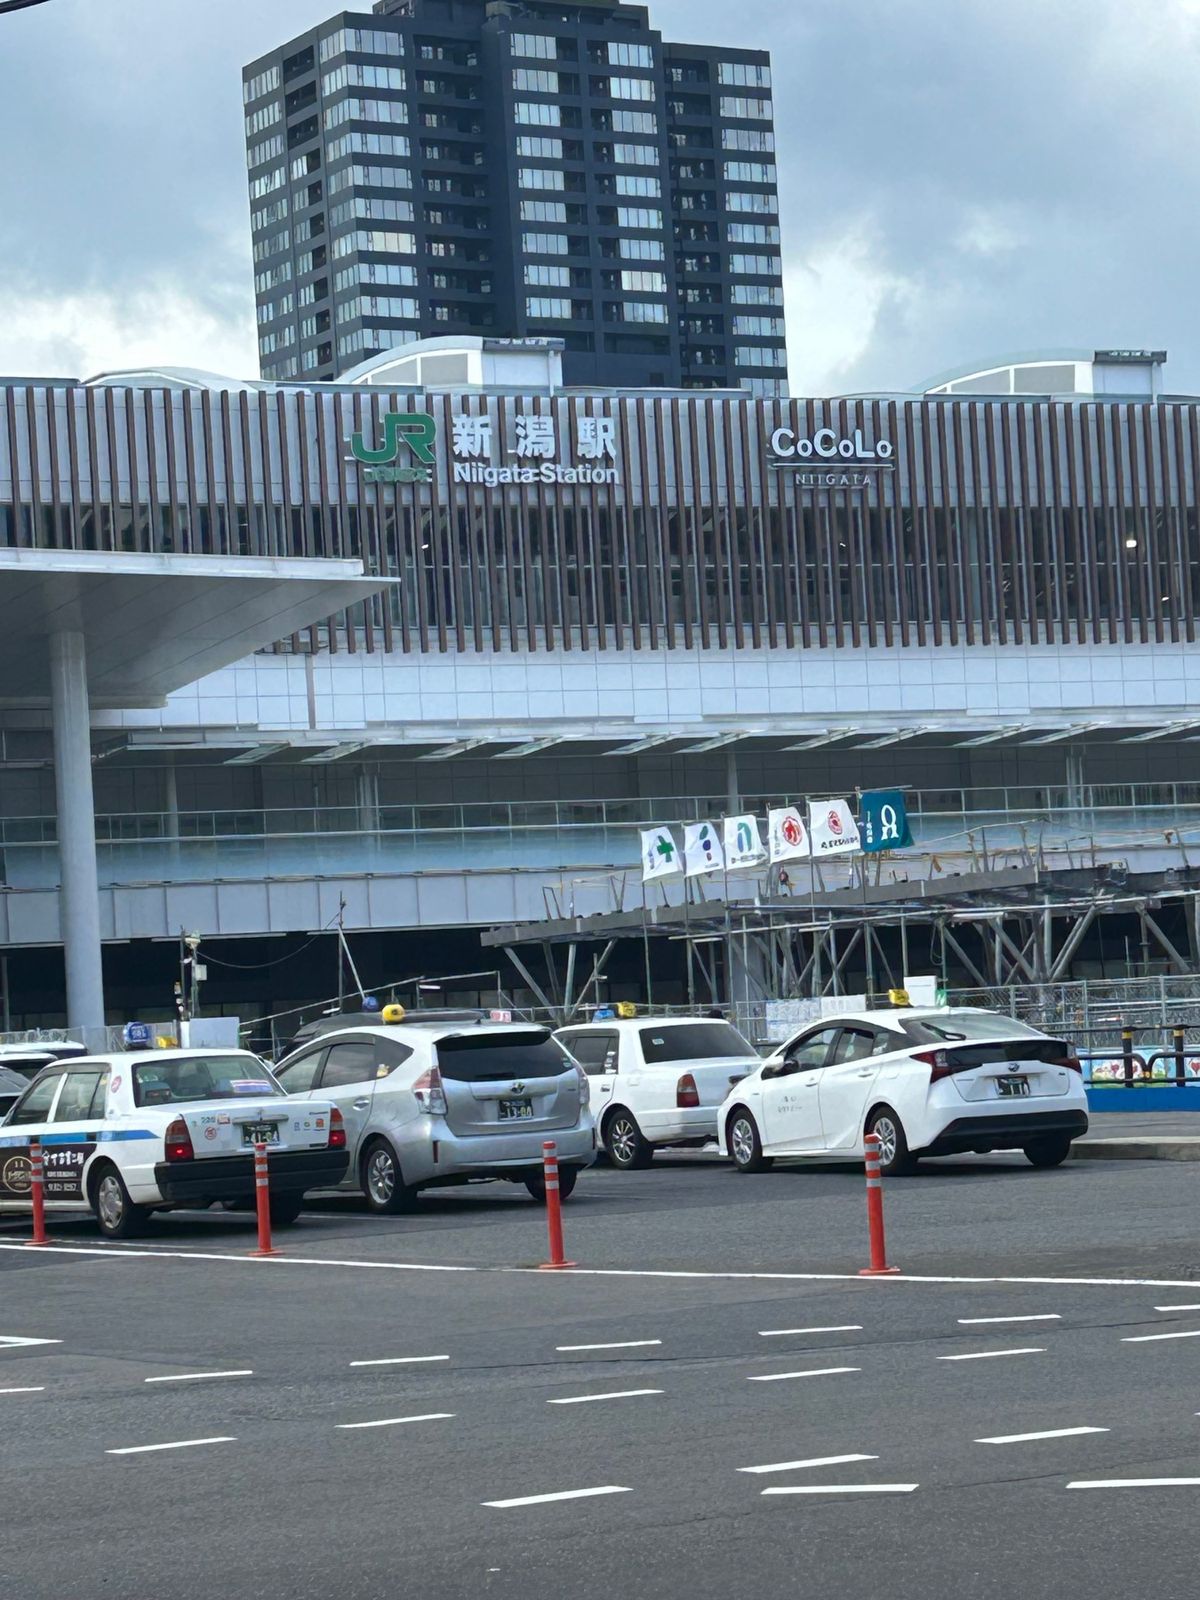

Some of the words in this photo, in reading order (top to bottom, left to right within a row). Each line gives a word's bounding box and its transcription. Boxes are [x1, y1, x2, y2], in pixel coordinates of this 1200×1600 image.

[351, 412, 437, 464] JR
[452, 414, 618, 460] 新潟駅
[771, 427, 893, 458] CoCoLo
[453, 462, 533, 487] Niigata
[540, 464, 619, 484] Station
[795, 473, 872, 486] NIIGATA
